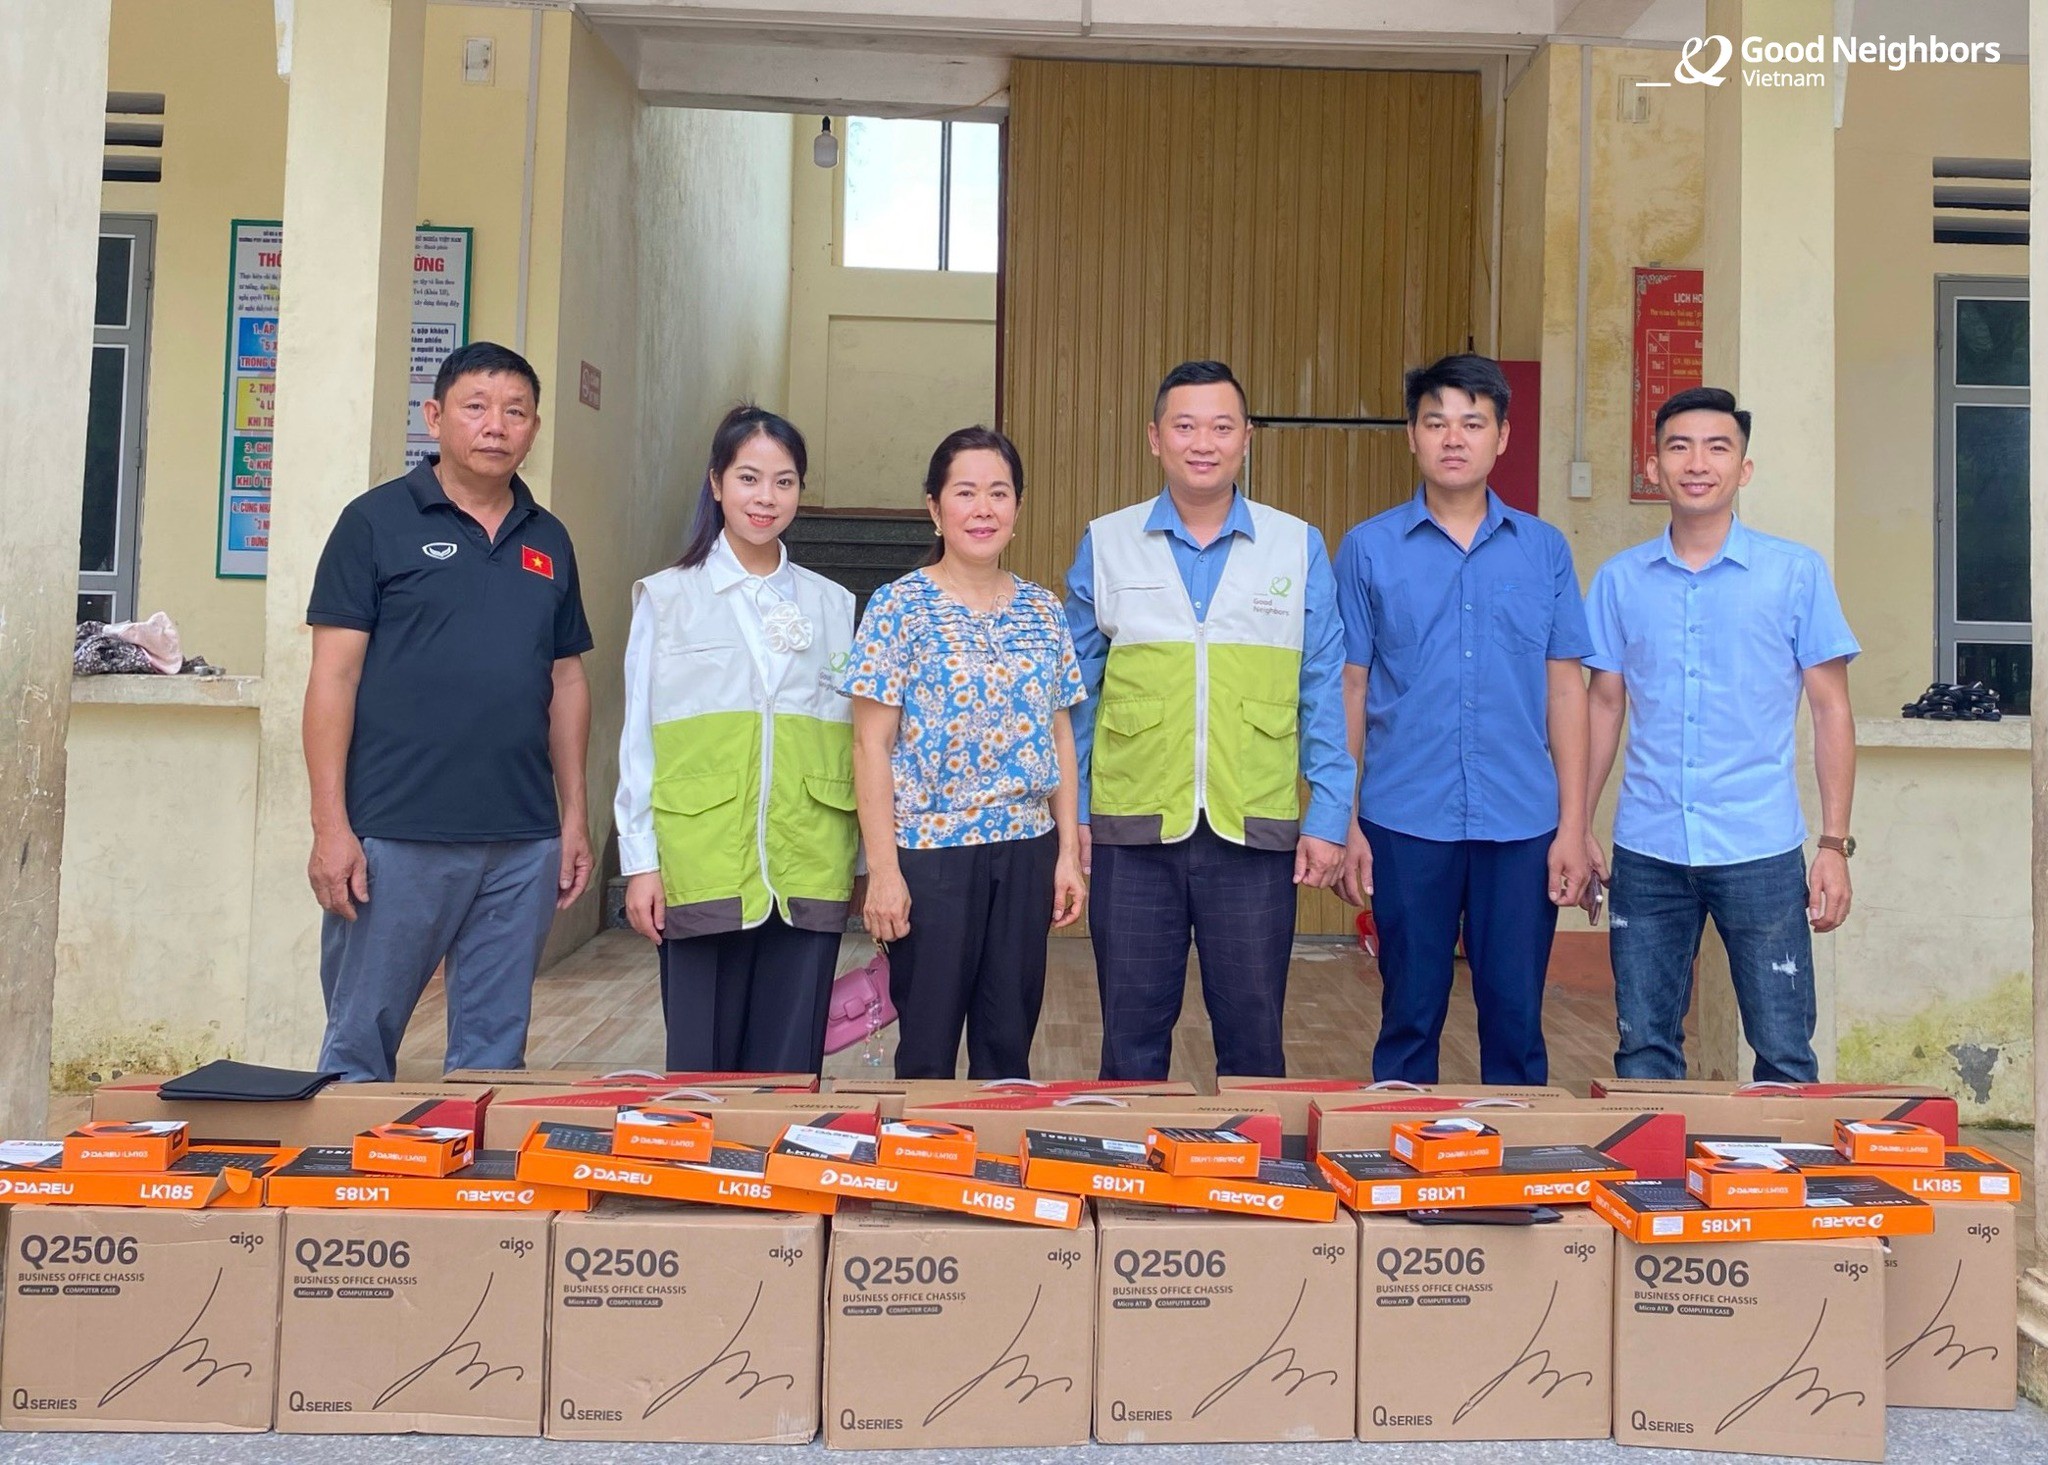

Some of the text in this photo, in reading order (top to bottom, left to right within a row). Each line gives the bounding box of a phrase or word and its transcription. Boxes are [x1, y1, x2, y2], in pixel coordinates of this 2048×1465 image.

[414, 253, 444, 272] ỜNG
[1692, 293, 1703, 303] HO
[241, 356, 268, 367] TRONG
[1253, 598, 1272, 606] Good
[1253, 606, 1289, 616] Neighbors
[904, 1149, 932, 1158] DAREU
[593, 1167, 653, 1185] DAREU
[839, 1173, 898, 1193] DAREU
[14, 1182, 74, 1195] DAREU
[140, 1184, 194, 1200] LK185
[718, 1180, 772, 1199] LK185
[1092, 1174, 1145, 1195] LK185
[1523, 1183, 1575, 1196] DAREU
[1913, 1178, 1962, 1192] LK185
[335, 1187, 389, 1201] LK185
[457, 1190, 515, 1202] DAREU
[962, 1190, 1015, 1212] LK185
[1209, 1189, 1267, 1206] DAREU
[1418, 1186, 1465, 1201] LK185
[1702, 1218, 1751, 1233] LK185
[1812, 1216, 1867, 1228] DAREU
[1967, 1223, 2000, 1243] aigo
[230, 1232, 263, 1253] aigo
[500, 1237, 533, 1258] aigo
[21, 1235, 138, 1270] Q2506
[296, 1238, 410, 1273] Q2506
[769, 1246, 803, 1267] aigo
[1048, 1248, 1081, 1270] aigo
[1313, 1243, 1345, 1264] aigo
[1564, 1242, 1596, 1262] aigo
[565, 1247, 679, 1282] Q2506
[1114, 1250, 1225, 1284] Q2506
[1377, 1248, 1485, 1282] Q2506
[1635, 1255, 1749, 1289] Q2506
[1834, 1261, 1868, 1281] aigo
[19, 1273, 144, 1281] BUSINESS OFFICE CHASSIS
[294, 1276, 417, 1285] BUSINESS OFFICE CHASSIS
[844, 1256, 959, 1291] Q2506
[564, 1285, 609, 1293] BUSINESS
[647, 1286, 686, 1294] CHASSIS
[1113, 1287, 1157, 1295] BUSINESS
[1160, 1286, 1191, 1294] OFFICE
[1377, 1284, 1493, 1293] BUSINESS OFFICE CHASSIS
[843, 1292, 965, 1302] BUSINESS OFFICE CHASSIS
[1635, 1291, 1758, 1305] BUSINESS OFFICE CHASSIS
[1680, 1306, 1713, 1314] COMPUTER
